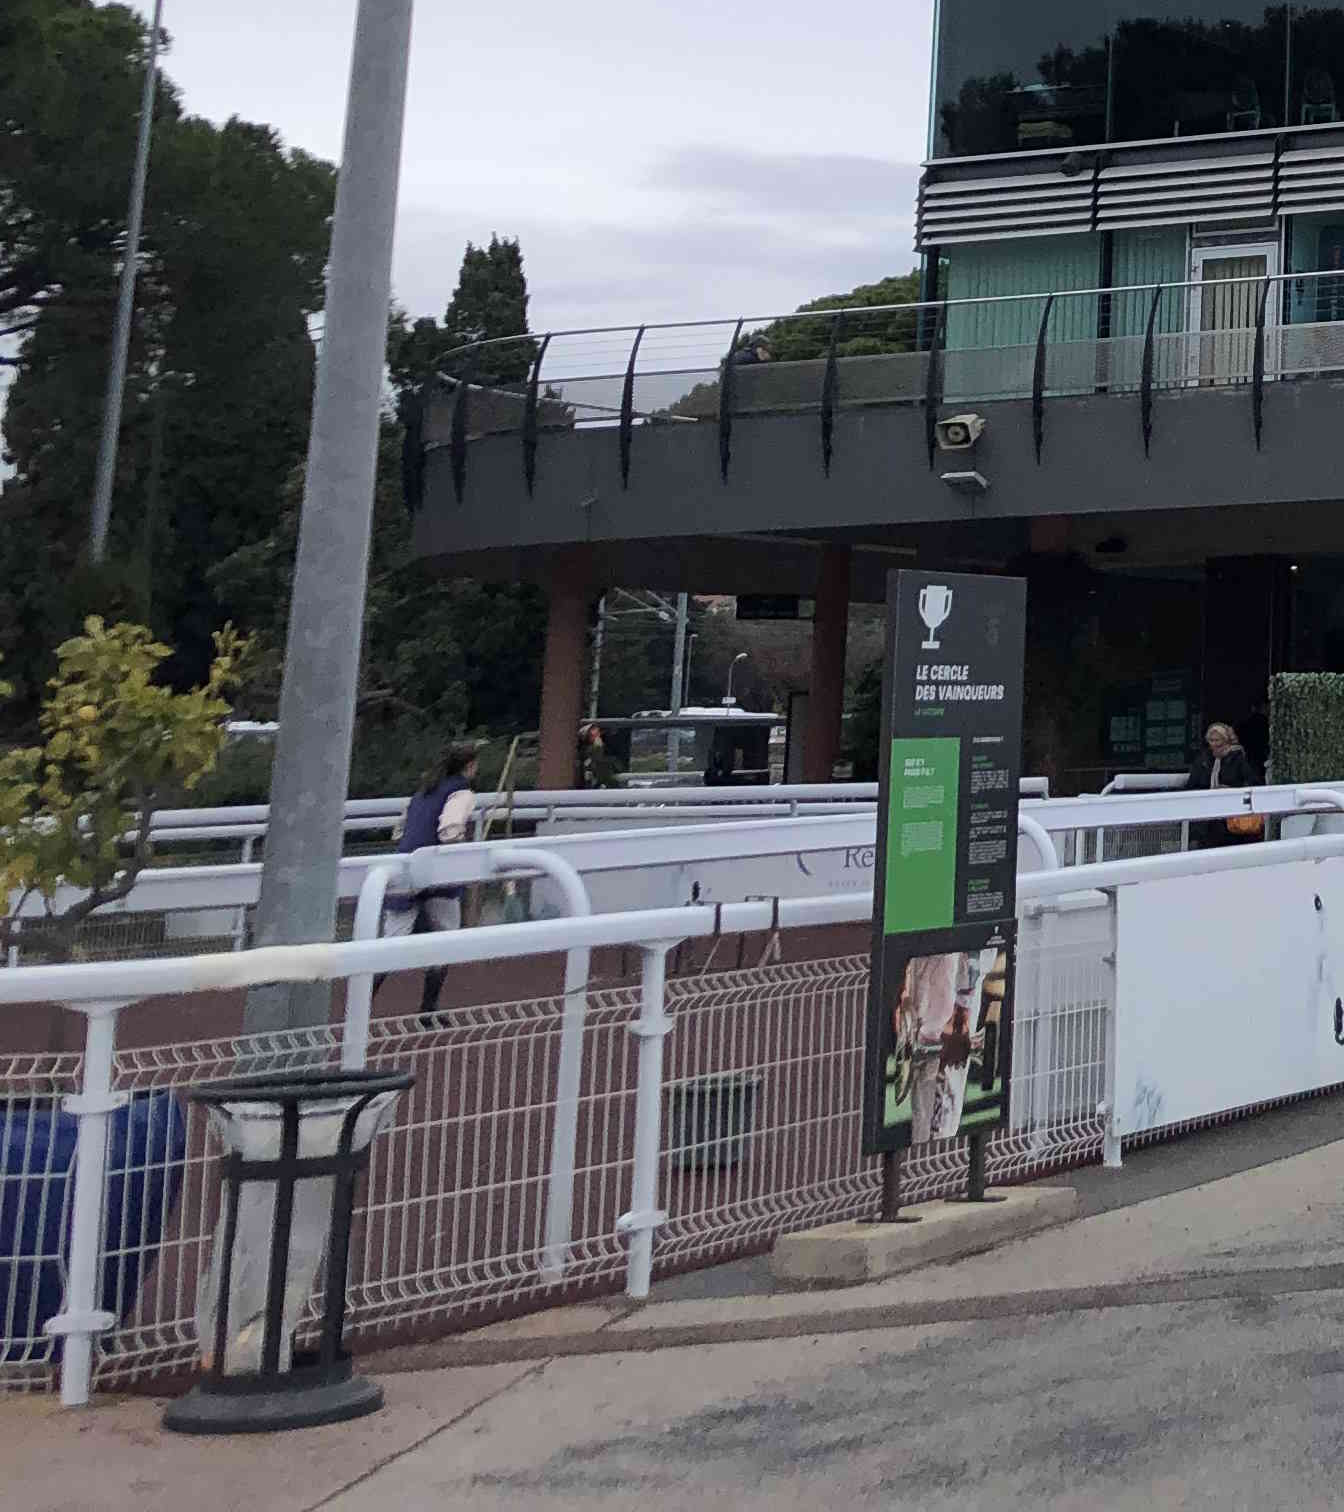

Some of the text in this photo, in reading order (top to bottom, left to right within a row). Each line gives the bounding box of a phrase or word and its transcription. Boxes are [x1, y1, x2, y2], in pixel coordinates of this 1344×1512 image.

[916, 664, 969, 681] LE CERCLE
[915, 684, 1005, 701] DES VAINQUEURS
